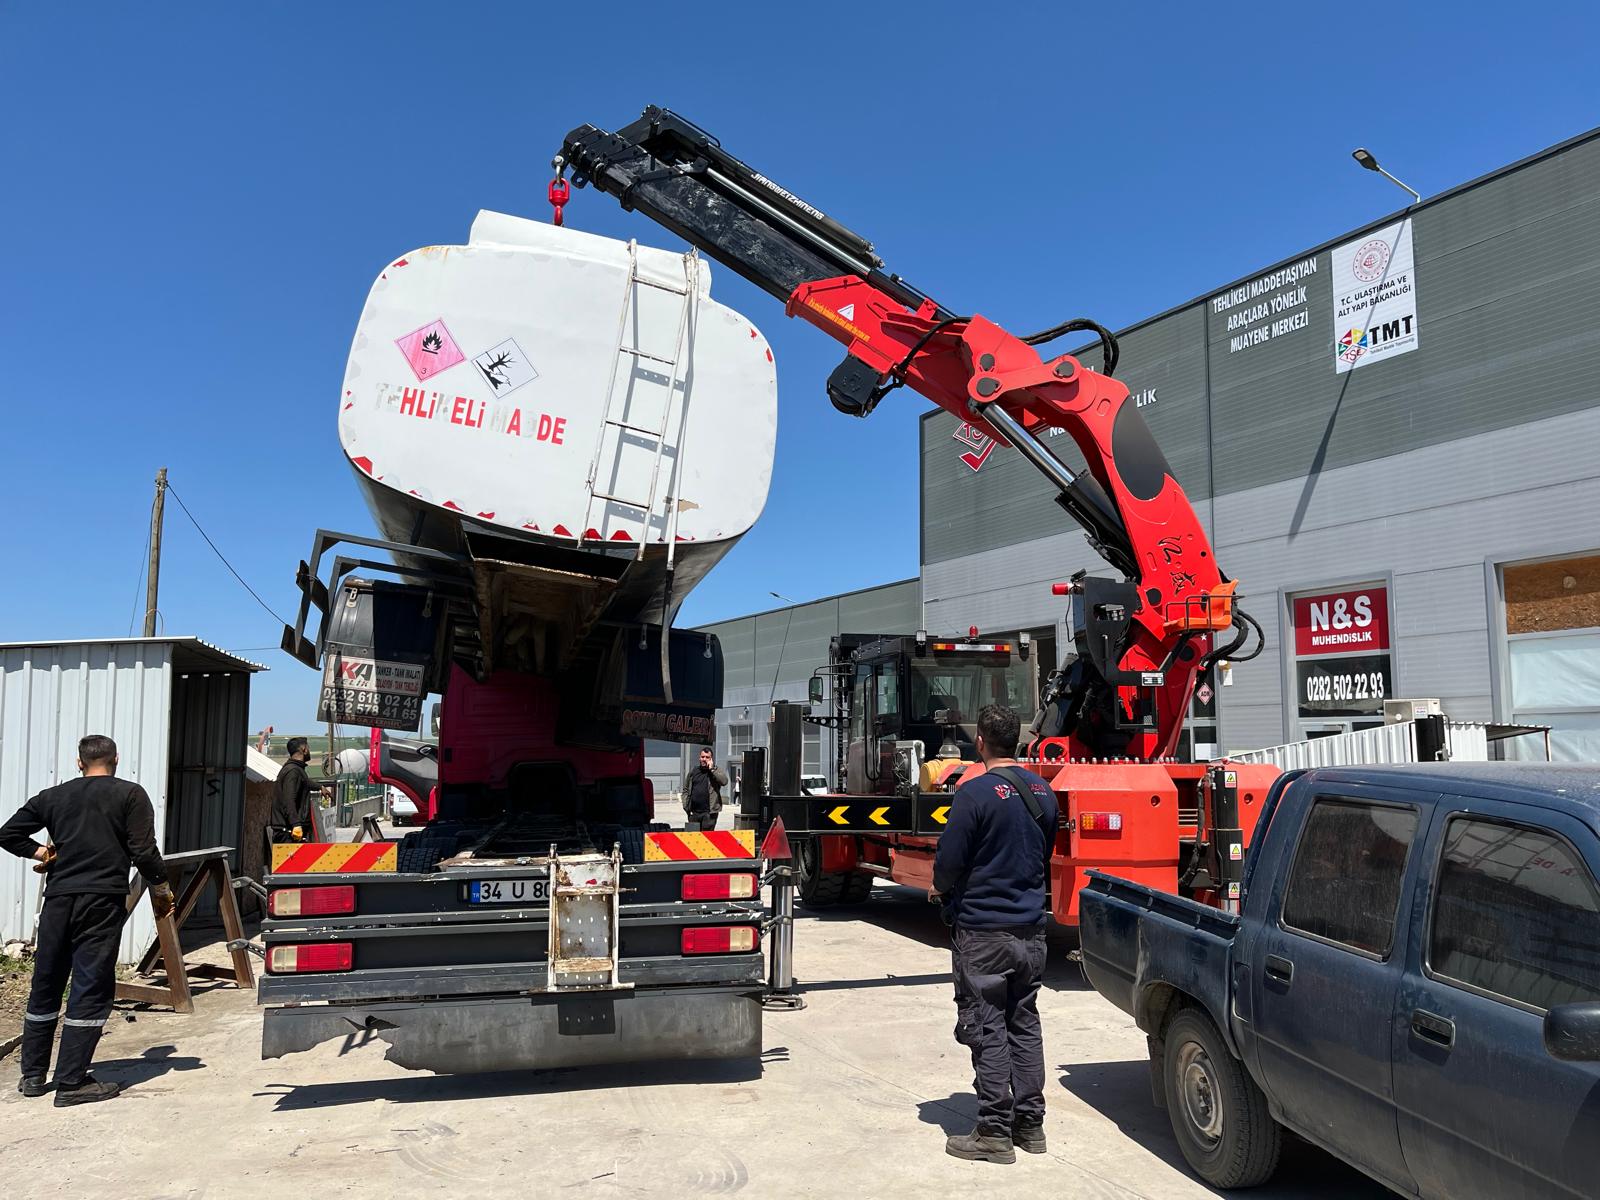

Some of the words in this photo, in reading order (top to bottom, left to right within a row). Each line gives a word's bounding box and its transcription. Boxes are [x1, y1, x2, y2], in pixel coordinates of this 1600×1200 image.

[1213, 282, 1250, 314] TEHLİKELİ
[1338, 308, 1350, 318] ALT
[1352, 302, 1368, 315] YAPI
[1369, 285, 1411, 308] BAKANLIĞI
[1341, 296, 1353, 306] T.C.
[1354, 281, 1396, 302] ULAŞTIRMA
[1397, 275, 1407, 284] VE
[1227, 301, 1269, 331] ARAÇLARA
[1270, 285, 1307, 313] YÖNELİK
[1230, 329, 1270, 353] MUAYENE
[1272, 308, 1309, 338] MERKEZİ
[1369, 315, 1413, 345] TMT
[1345, 348, 1362, 360] TSE
[1310, 595, 1373, 632] N&S
[323, 687, 355, 702] 0232
[358, 691, 381, 704] 618
[384, 694, 400, 706] 02
[403, 697, 418, 709] 41
[1307, 676, 1331, 701] 0282
[1333, 674, 1352, 700] 502
[1354, 673, 1368, 699] 22
[1370, 672, 1384, 698] 93
[321, 700, 353, 714] 0532
[356, 703, 380, 716] 578
[382, 706, 398, 719] 41
[401, 709, 418, 721] 65
[481, 883, 501, 899] 34
[512, 882, 525, 898] U
